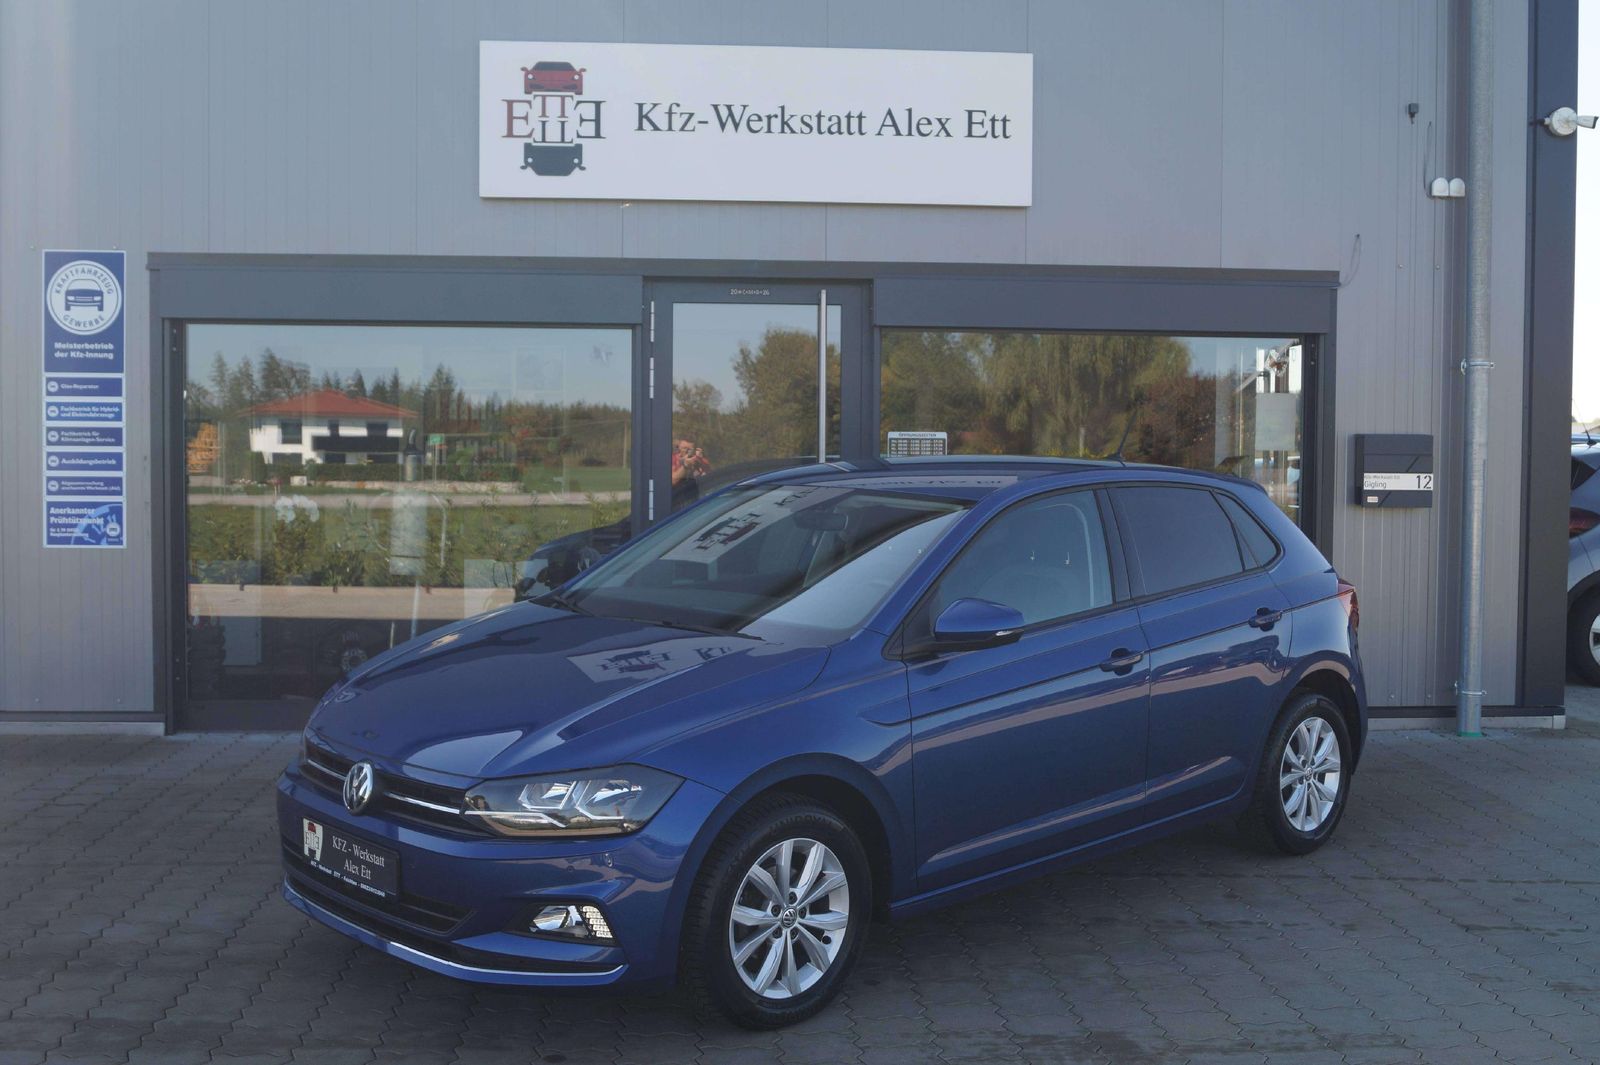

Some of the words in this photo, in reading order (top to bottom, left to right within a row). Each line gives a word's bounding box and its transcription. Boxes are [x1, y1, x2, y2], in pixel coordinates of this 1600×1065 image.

[633, 102, 867, 137] Kfz-Werkstatt
[874, 106, 953, 138] Alex
[963, 109, 1012, 139] Ett
[55, 267, 114, 295] KRAFTFAHRZEUG
[63, 313, 105, 328] GEWERBE
[54, 342, 114, 350] Meisterbetrieb
[70, 351, 114, 360] Kfz-Innung
[1416, 475, 1432, 489] 12
[332, 835, 347, 853] KFZ
[353, 844, 385, 867] Werkstatt
[343, 859, 359, 874] Alex
[361, 864, 371, 880] Ett
